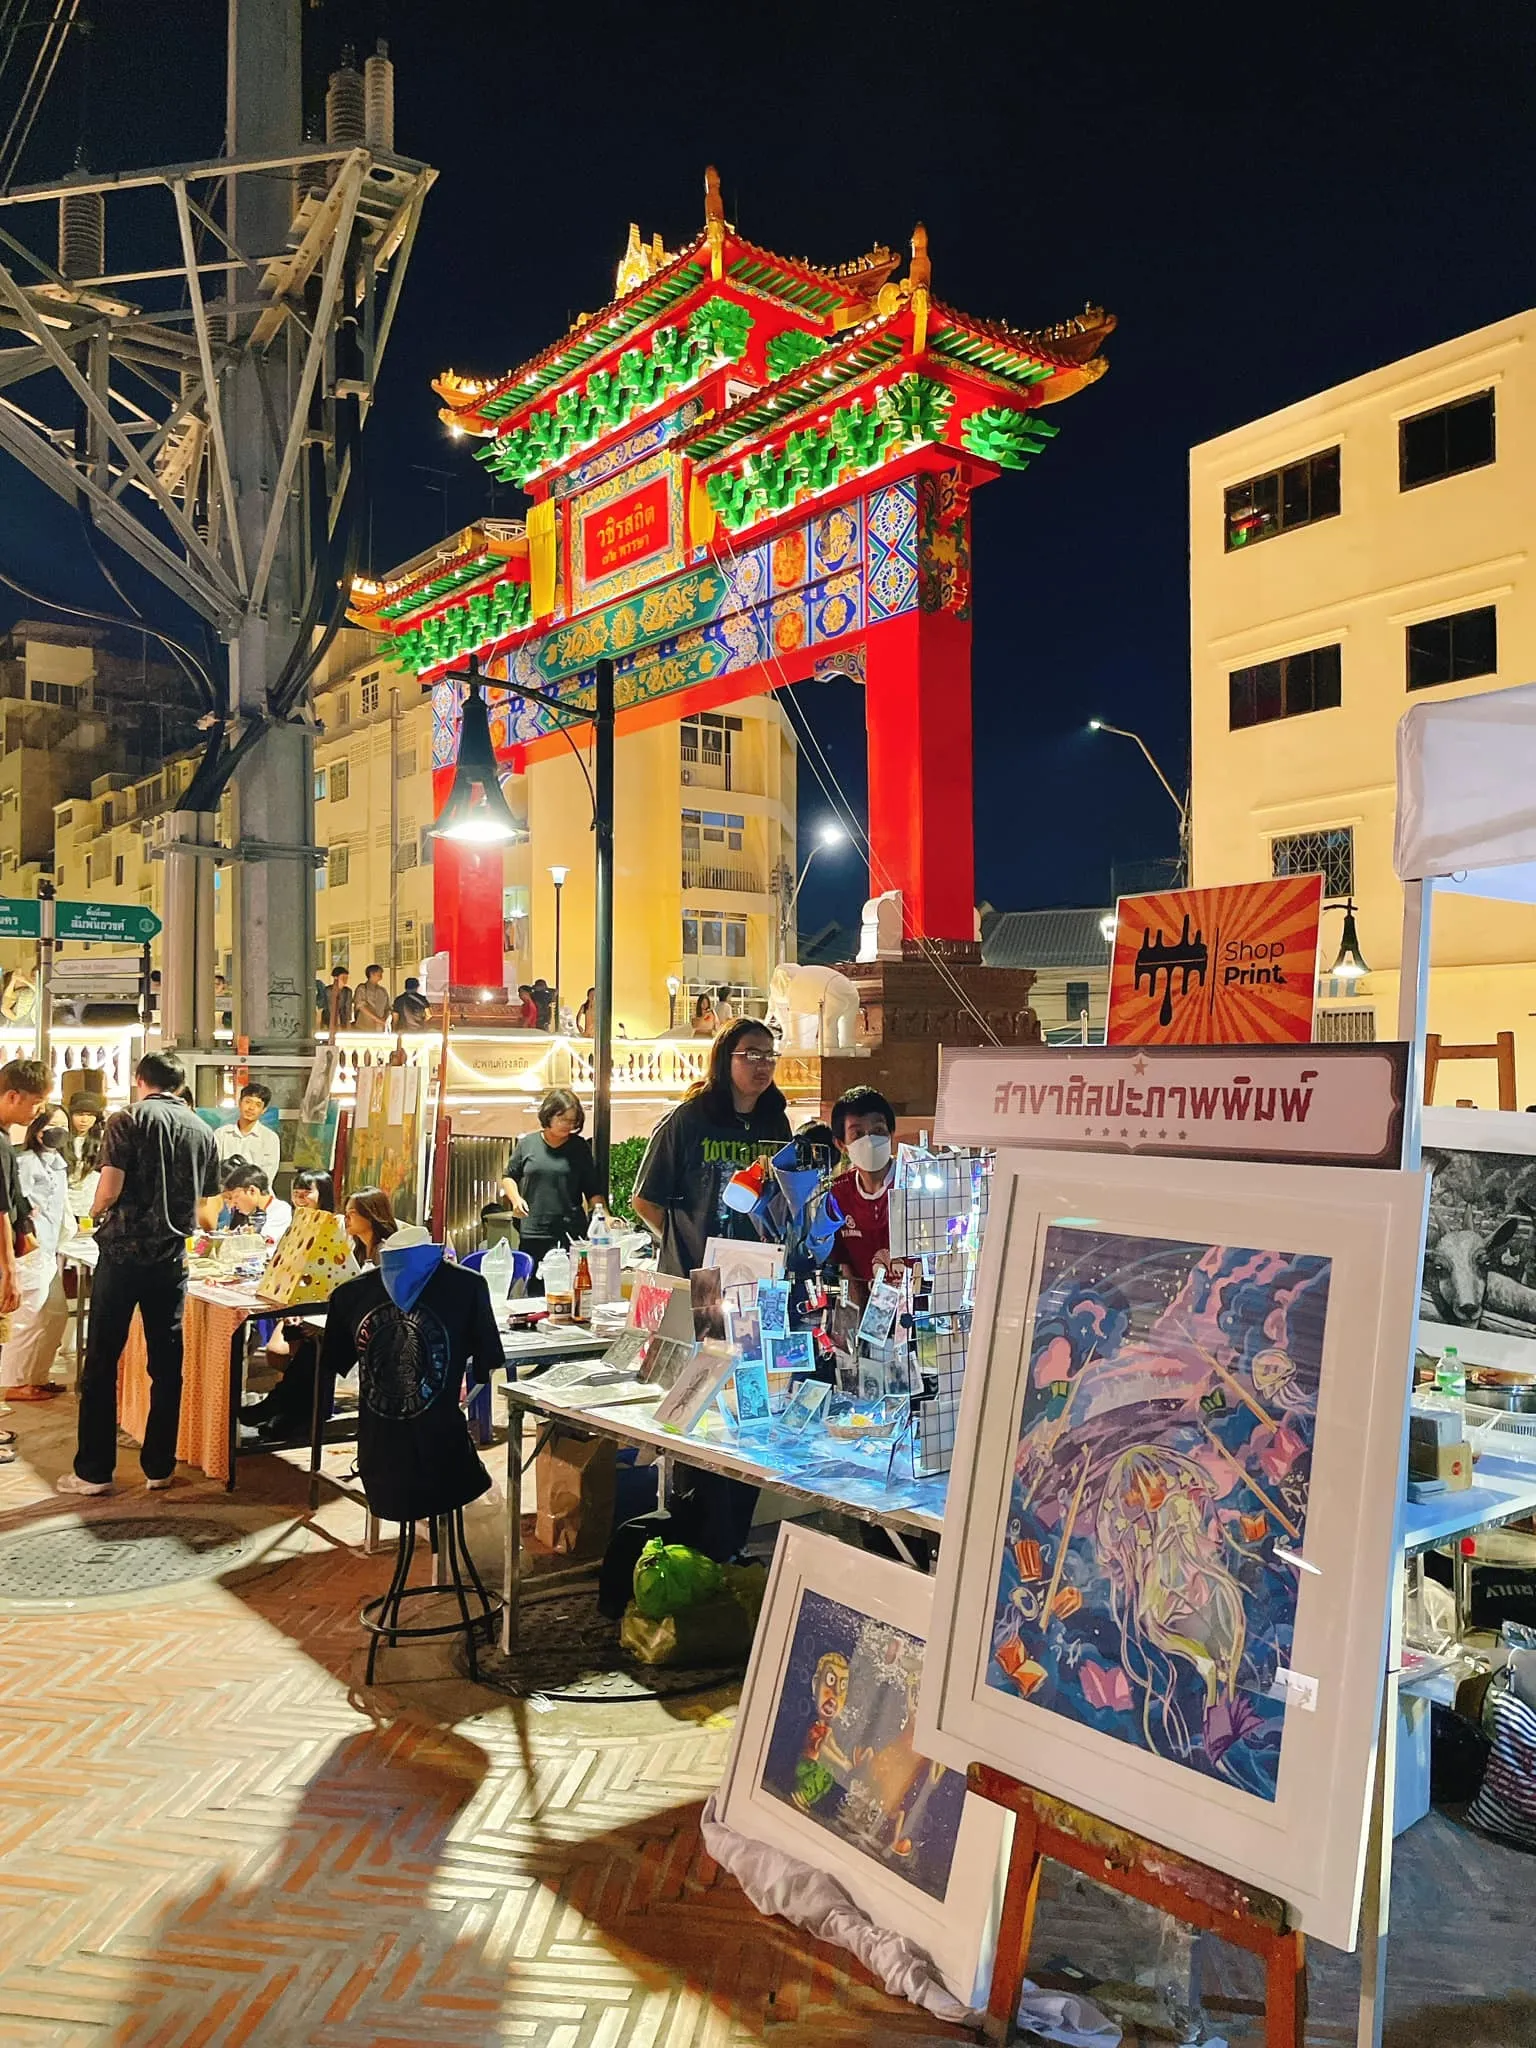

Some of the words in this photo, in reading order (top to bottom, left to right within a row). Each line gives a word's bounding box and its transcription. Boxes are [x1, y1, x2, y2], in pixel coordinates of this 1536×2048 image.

[596, 502, 654, 548] วชิรสถิต
[1225, 940, 1285, 963] Shop
[993, 1070, 1319, 1122] สาขาศิลปะภาพพิมพ์
